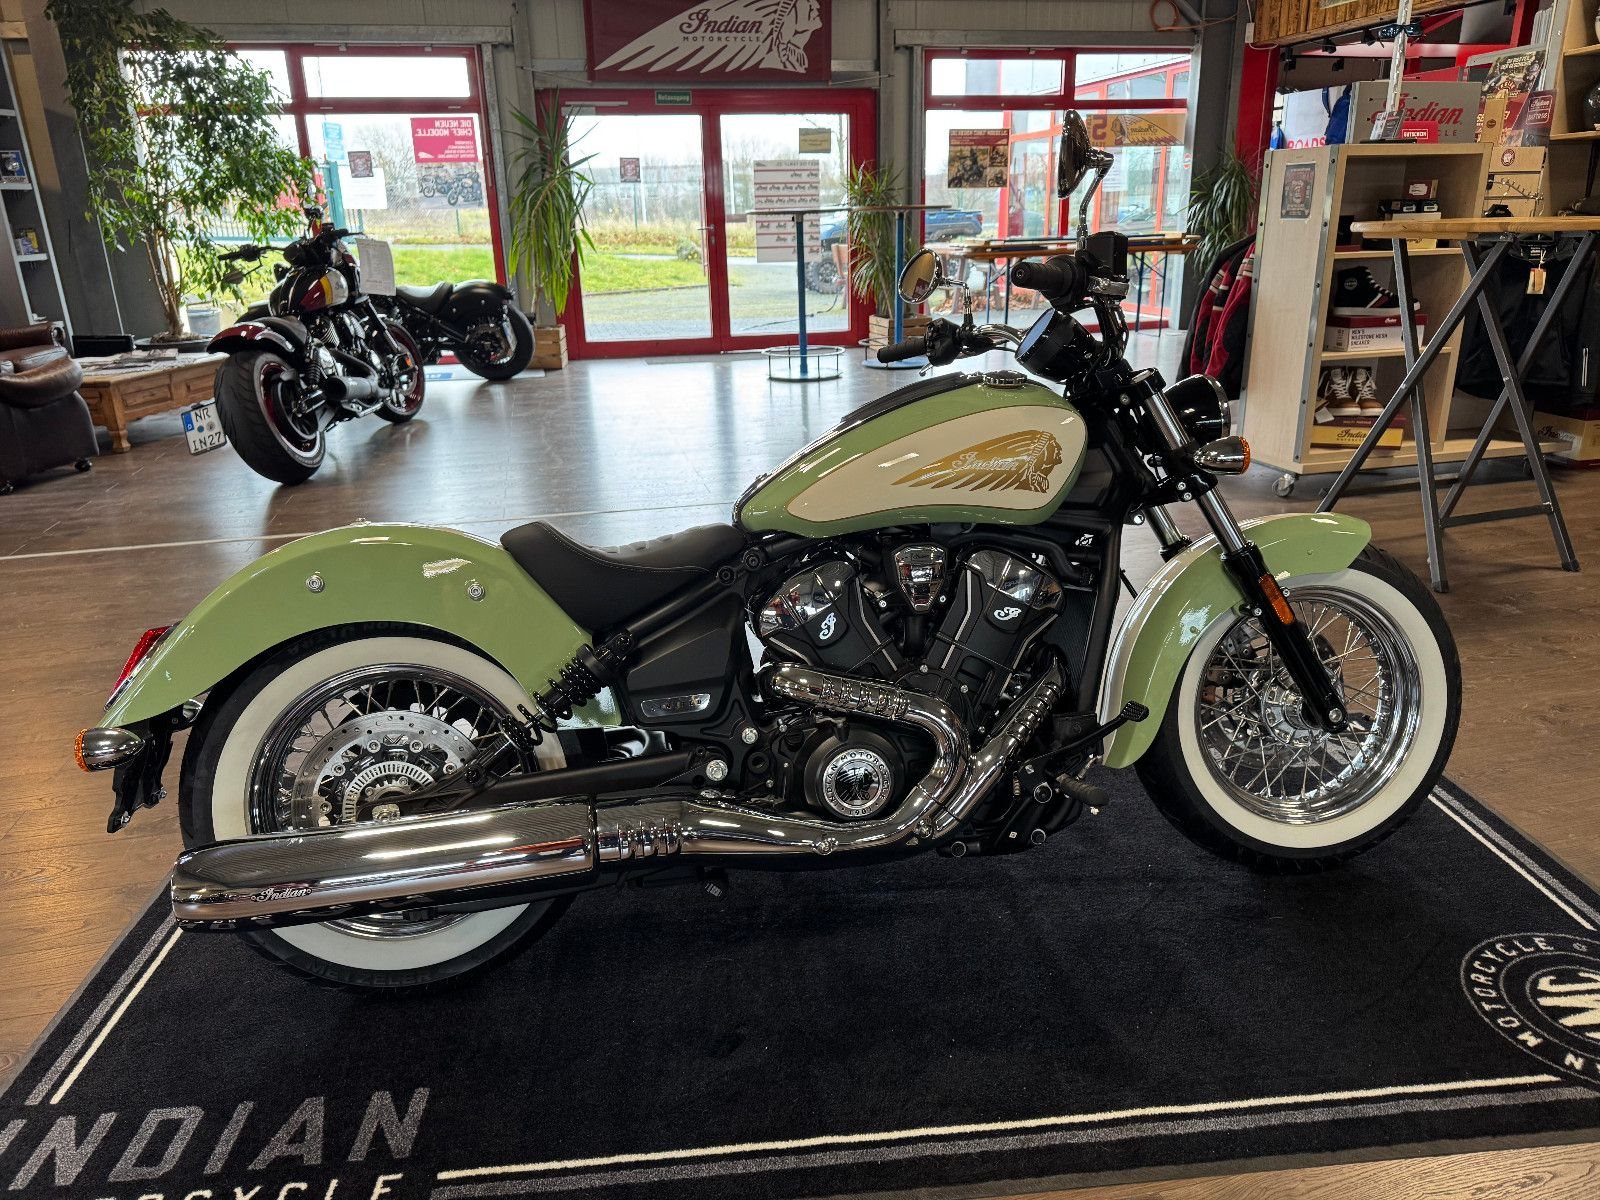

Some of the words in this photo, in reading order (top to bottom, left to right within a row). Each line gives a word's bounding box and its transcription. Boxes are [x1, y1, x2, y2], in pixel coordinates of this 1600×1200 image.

[679, 8, 763, 34] Indian
[194, 407, 212, 423] NR
[1336, 428, 1368, 439] India
[951, 451, 1018, 471] Indian
[256, 887, 307, 902] Indian
[1469, 936, 1555, 1049] MOTORCYCLE
